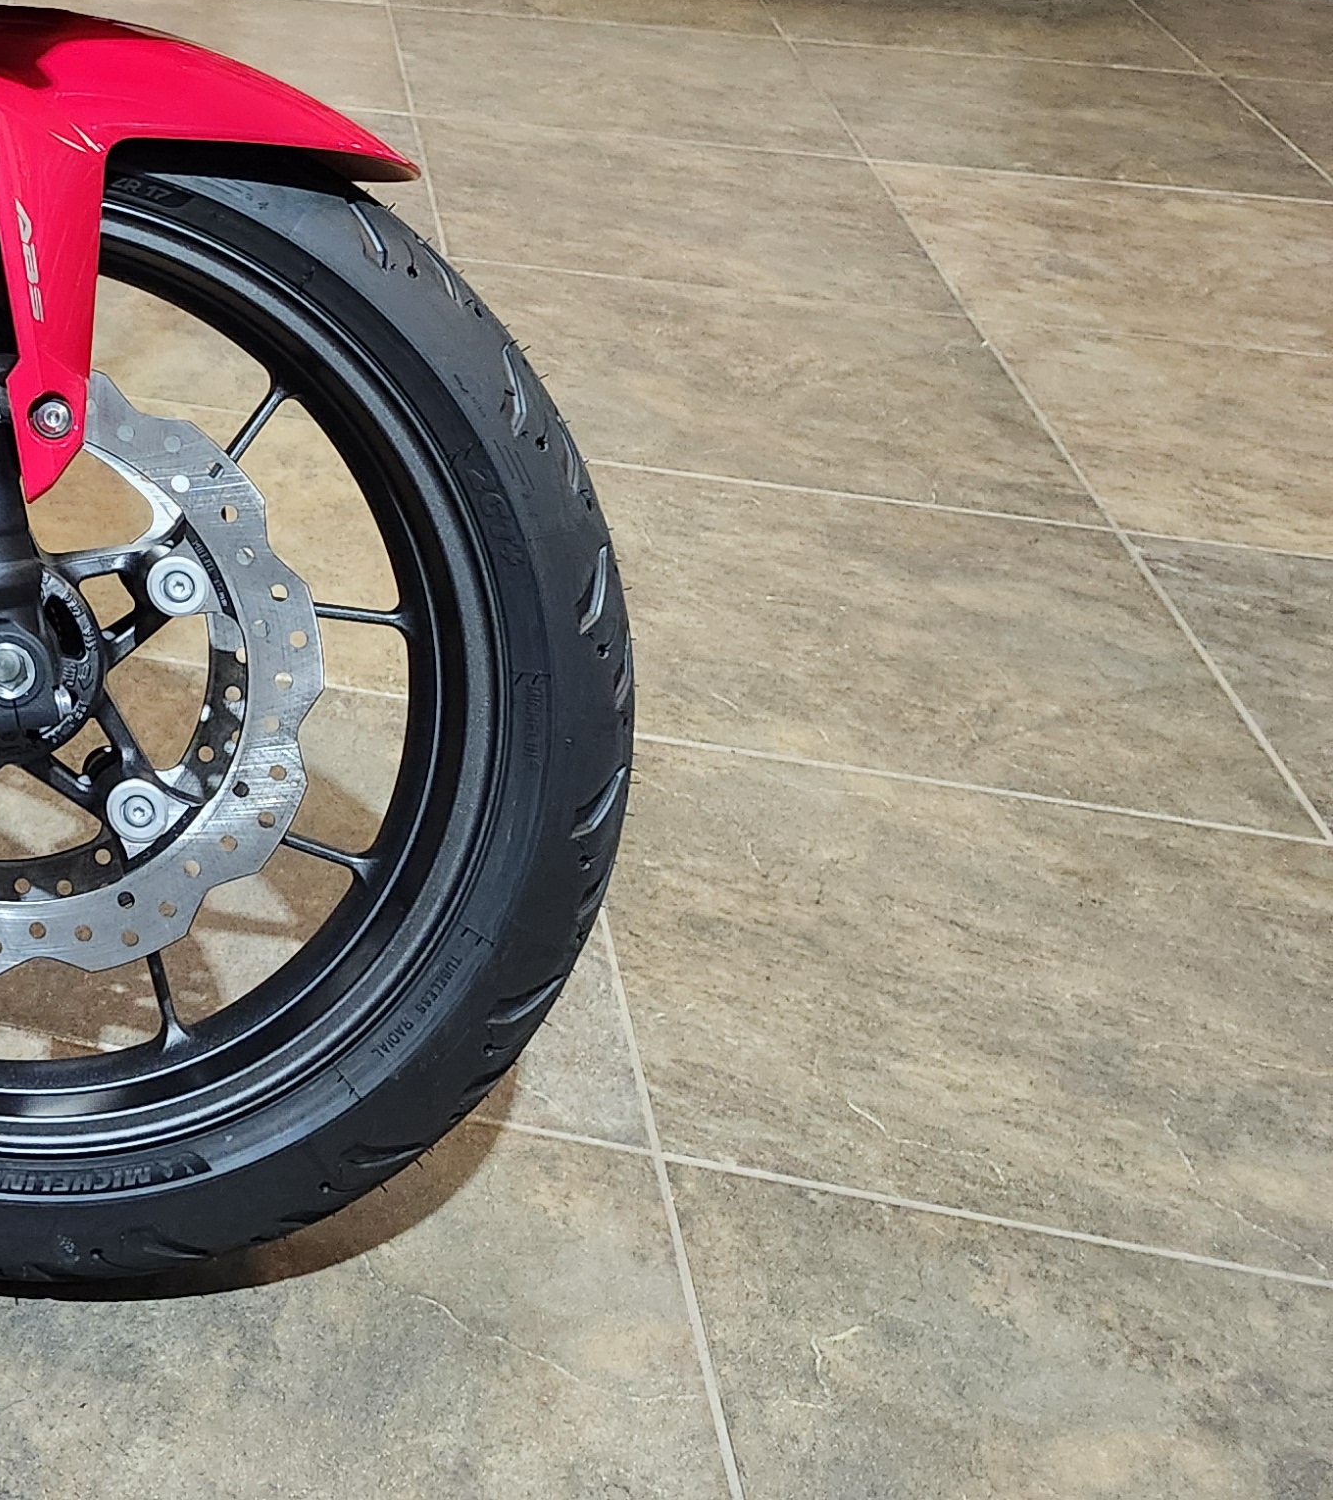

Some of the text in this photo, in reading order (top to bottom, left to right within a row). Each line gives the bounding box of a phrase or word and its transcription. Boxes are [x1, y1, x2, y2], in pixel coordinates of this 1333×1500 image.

[14, 198, 45, 323] ABS
[370, 955, 464, 1059] TUBELESS RADIAL
[0, 1164, 153, 1192] MICHELIN
